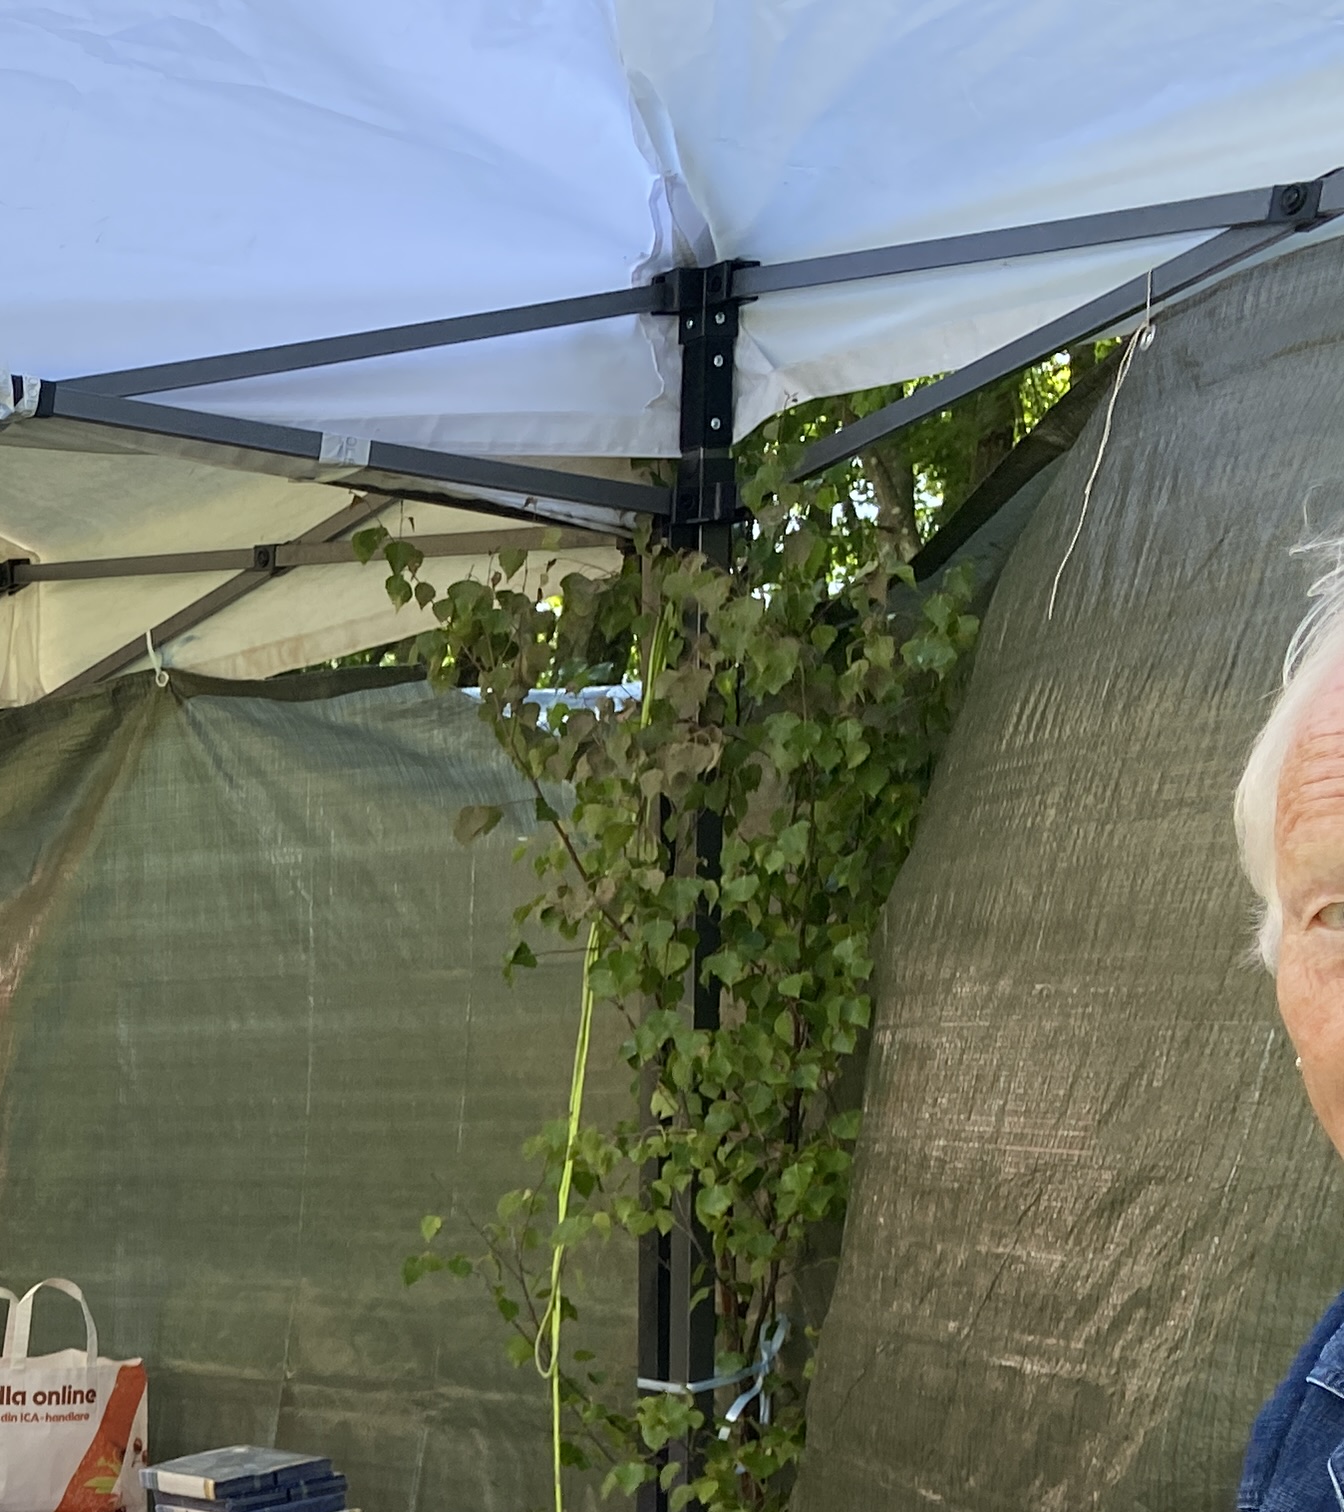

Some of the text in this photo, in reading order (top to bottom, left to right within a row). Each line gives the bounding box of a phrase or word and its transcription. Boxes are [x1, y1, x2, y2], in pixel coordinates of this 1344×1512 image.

[32, 1385, 97, 1406] online
[1, 1411, 18, 1423] din
[20, 1412, 90, 1424] ICA-handlare
